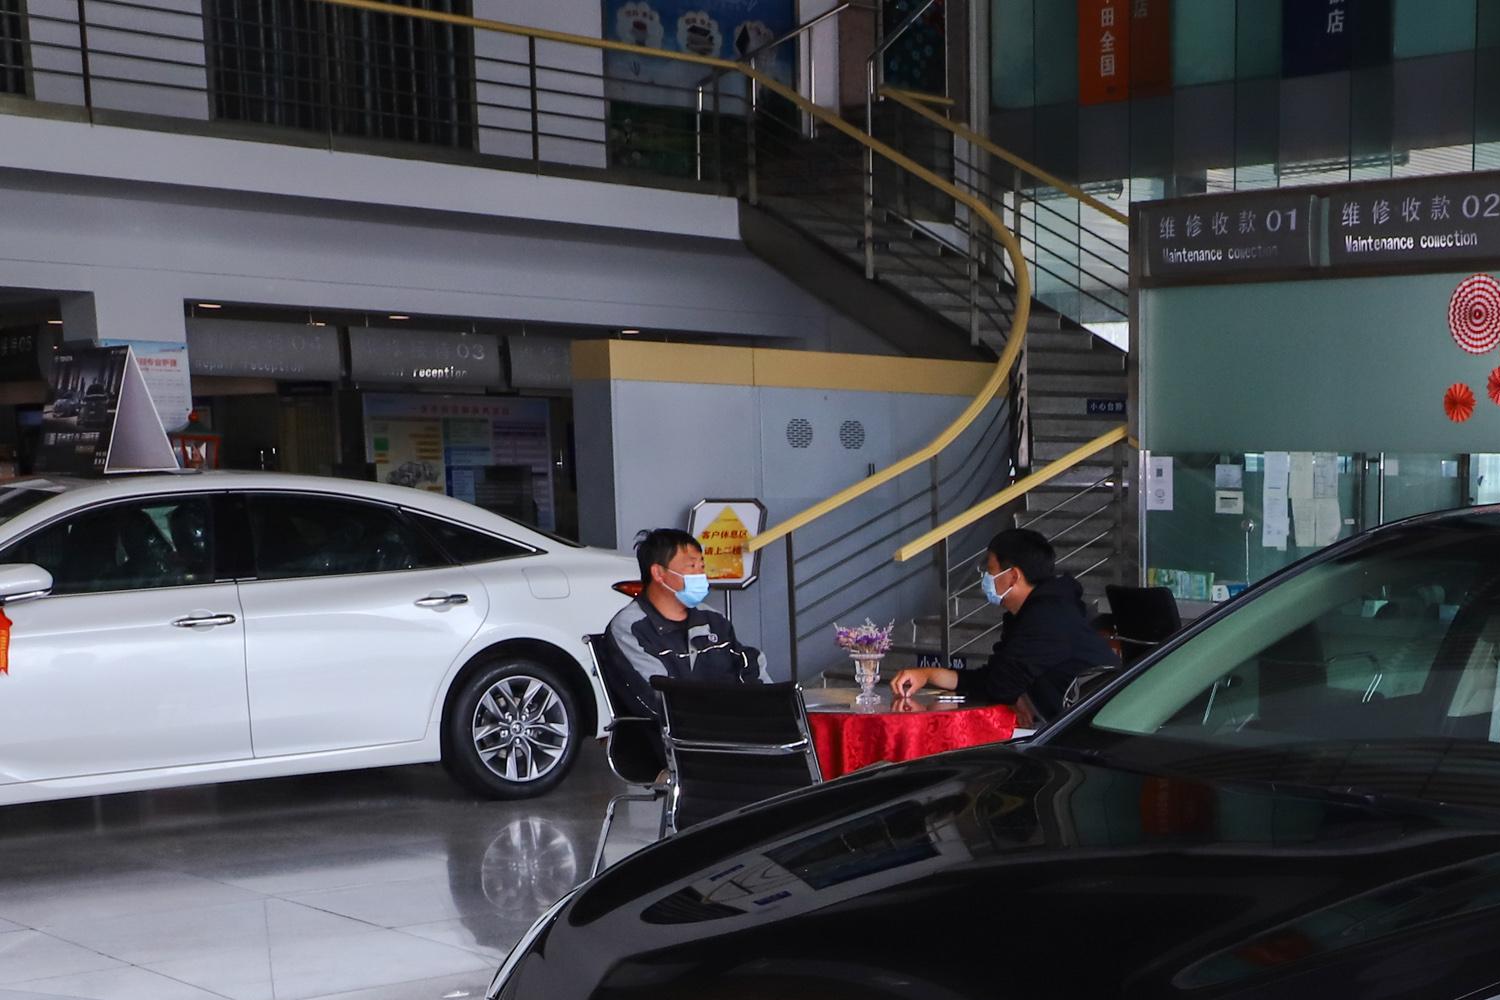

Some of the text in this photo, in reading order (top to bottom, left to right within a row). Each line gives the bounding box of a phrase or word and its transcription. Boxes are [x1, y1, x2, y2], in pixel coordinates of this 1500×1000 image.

[1100, 0, 1115, 77] 田全国
[1159, 208, 1297, 239] 维修收款 01
[1341, 193, 1500, 227] 维修收款 02
[1345, 234, 1414, 253] Maintenance
